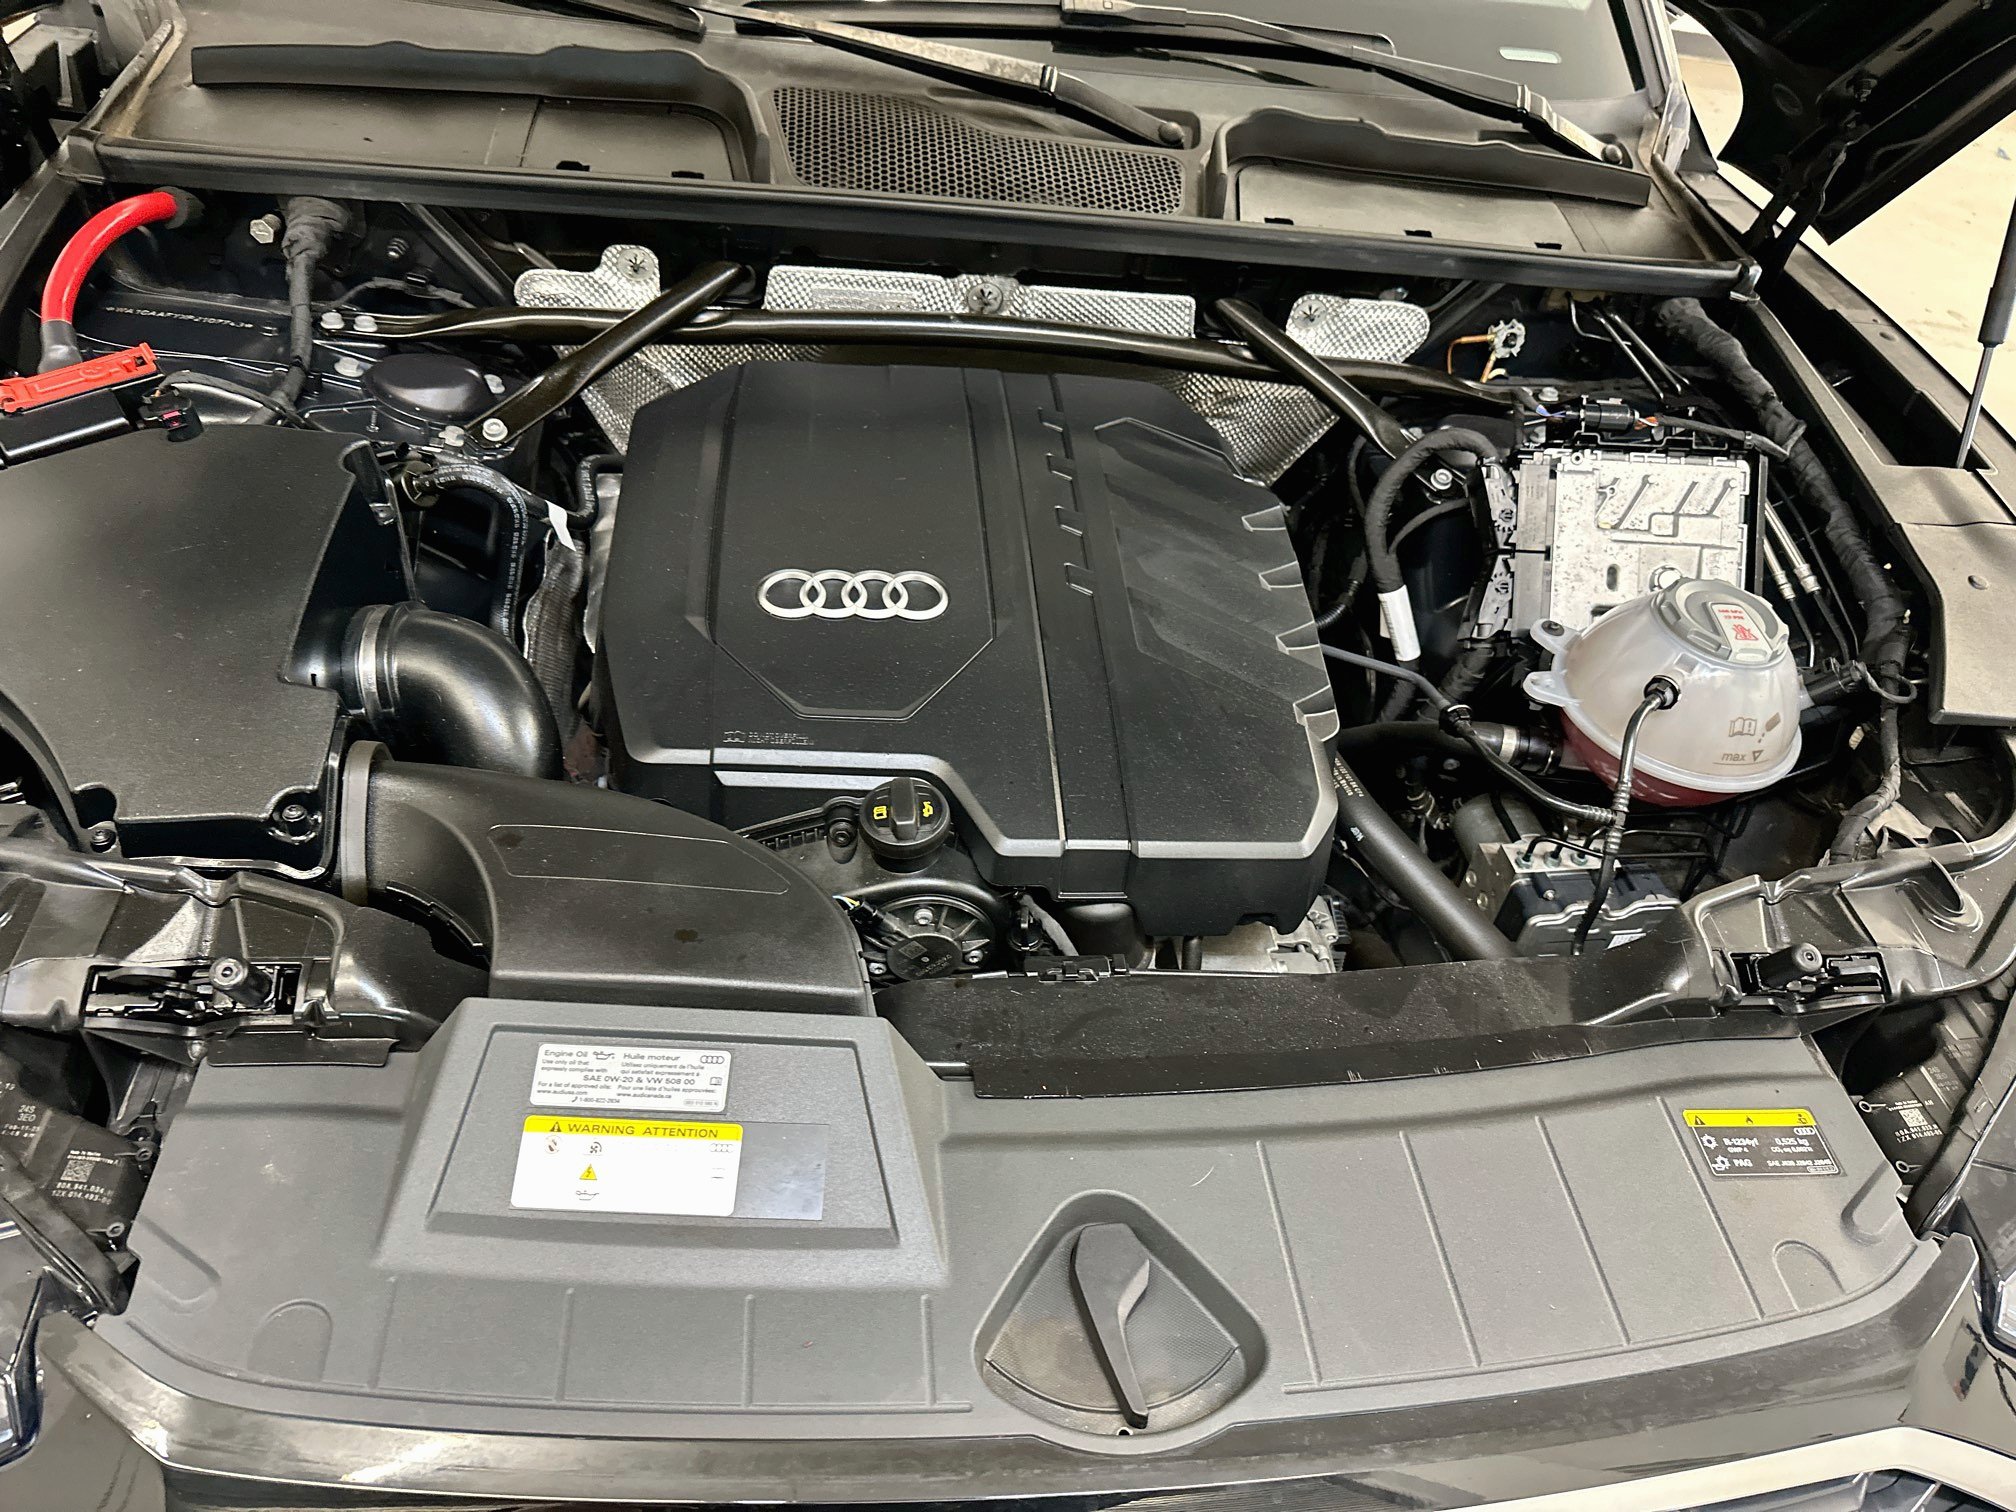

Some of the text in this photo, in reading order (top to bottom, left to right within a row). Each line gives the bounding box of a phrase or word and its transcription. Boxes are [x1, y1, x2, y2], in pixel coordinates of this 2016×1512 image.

[1721, 751, 1747, 762] max
[544, 1050, 574, 1058] Engine
[568, 1124, 719, 1138] WARNING ATTENTION
[1796, 1137, 1810, 1146] kg
